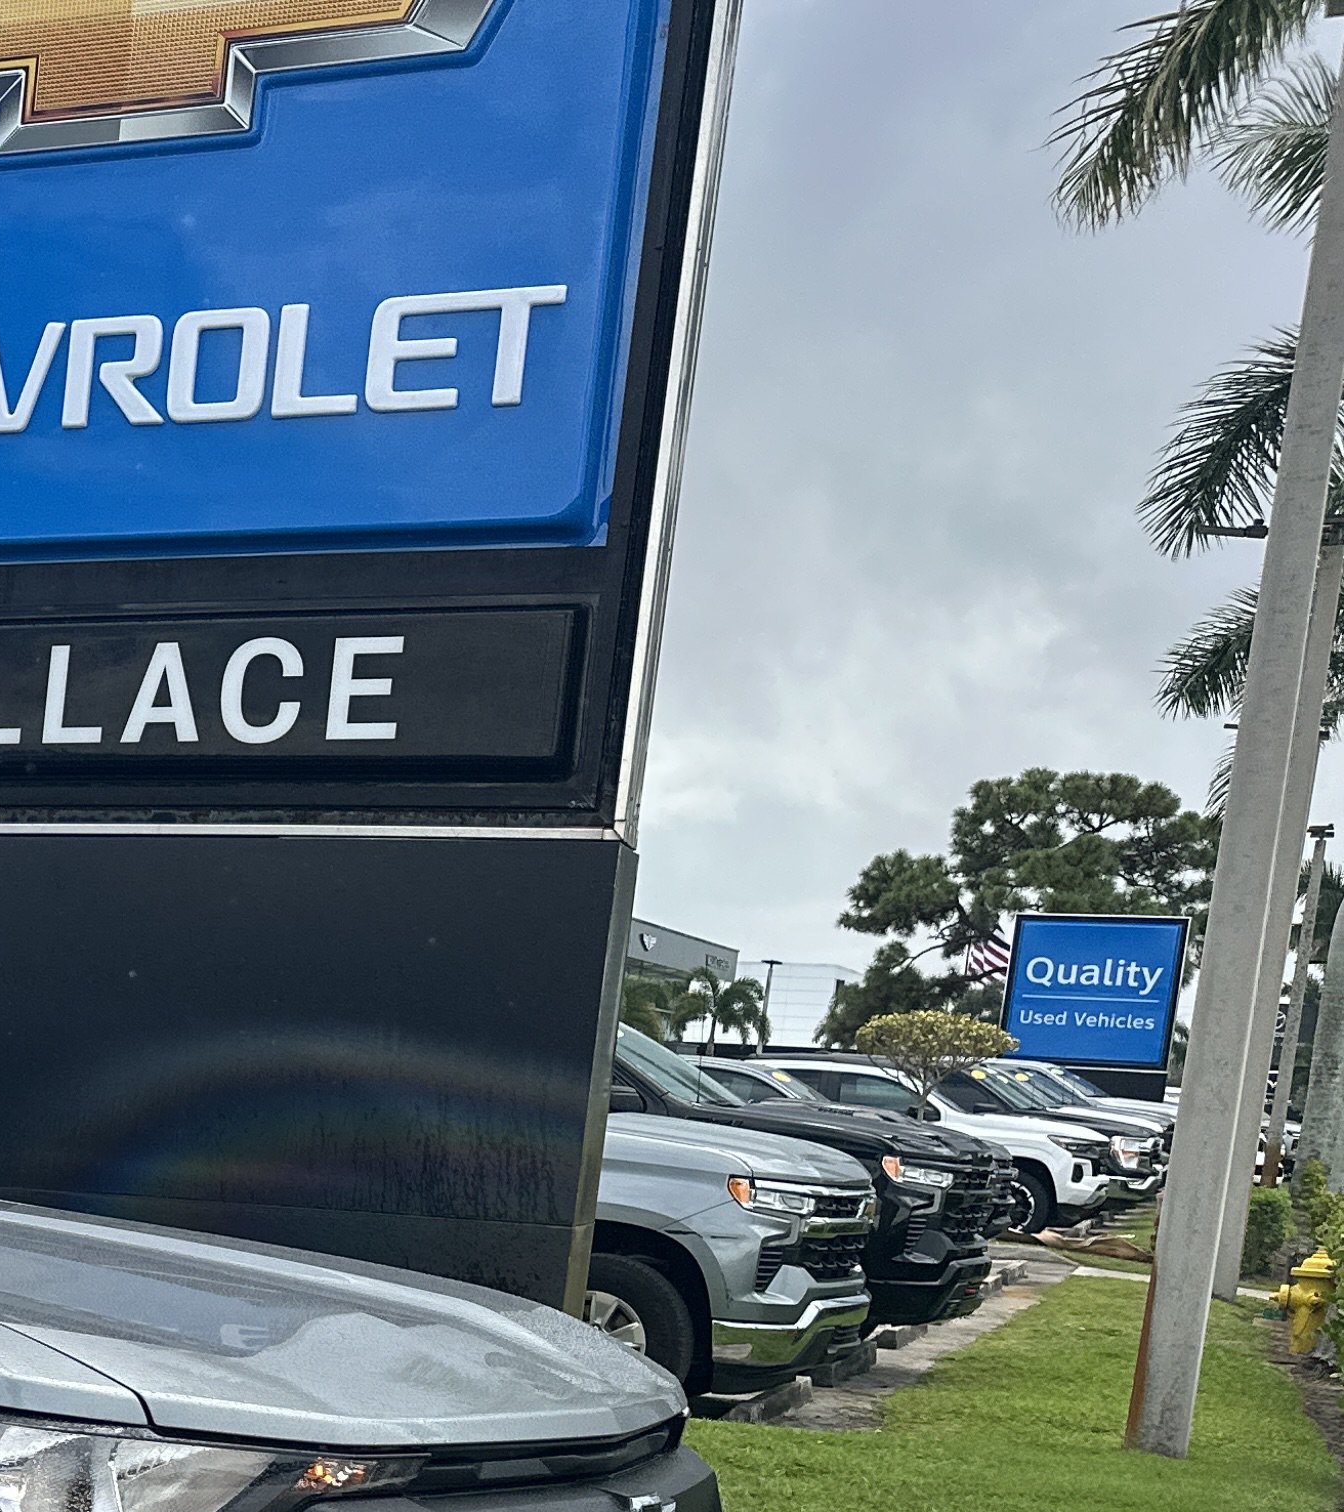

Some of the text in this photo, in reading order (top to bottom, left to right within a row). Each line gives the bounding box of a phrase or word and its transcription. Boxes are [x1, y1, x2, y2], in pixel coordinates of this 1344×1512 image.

[1025, 956, 1164, 996] Quality
[1019, 1009, 1156, 1030] Used Vehicles
